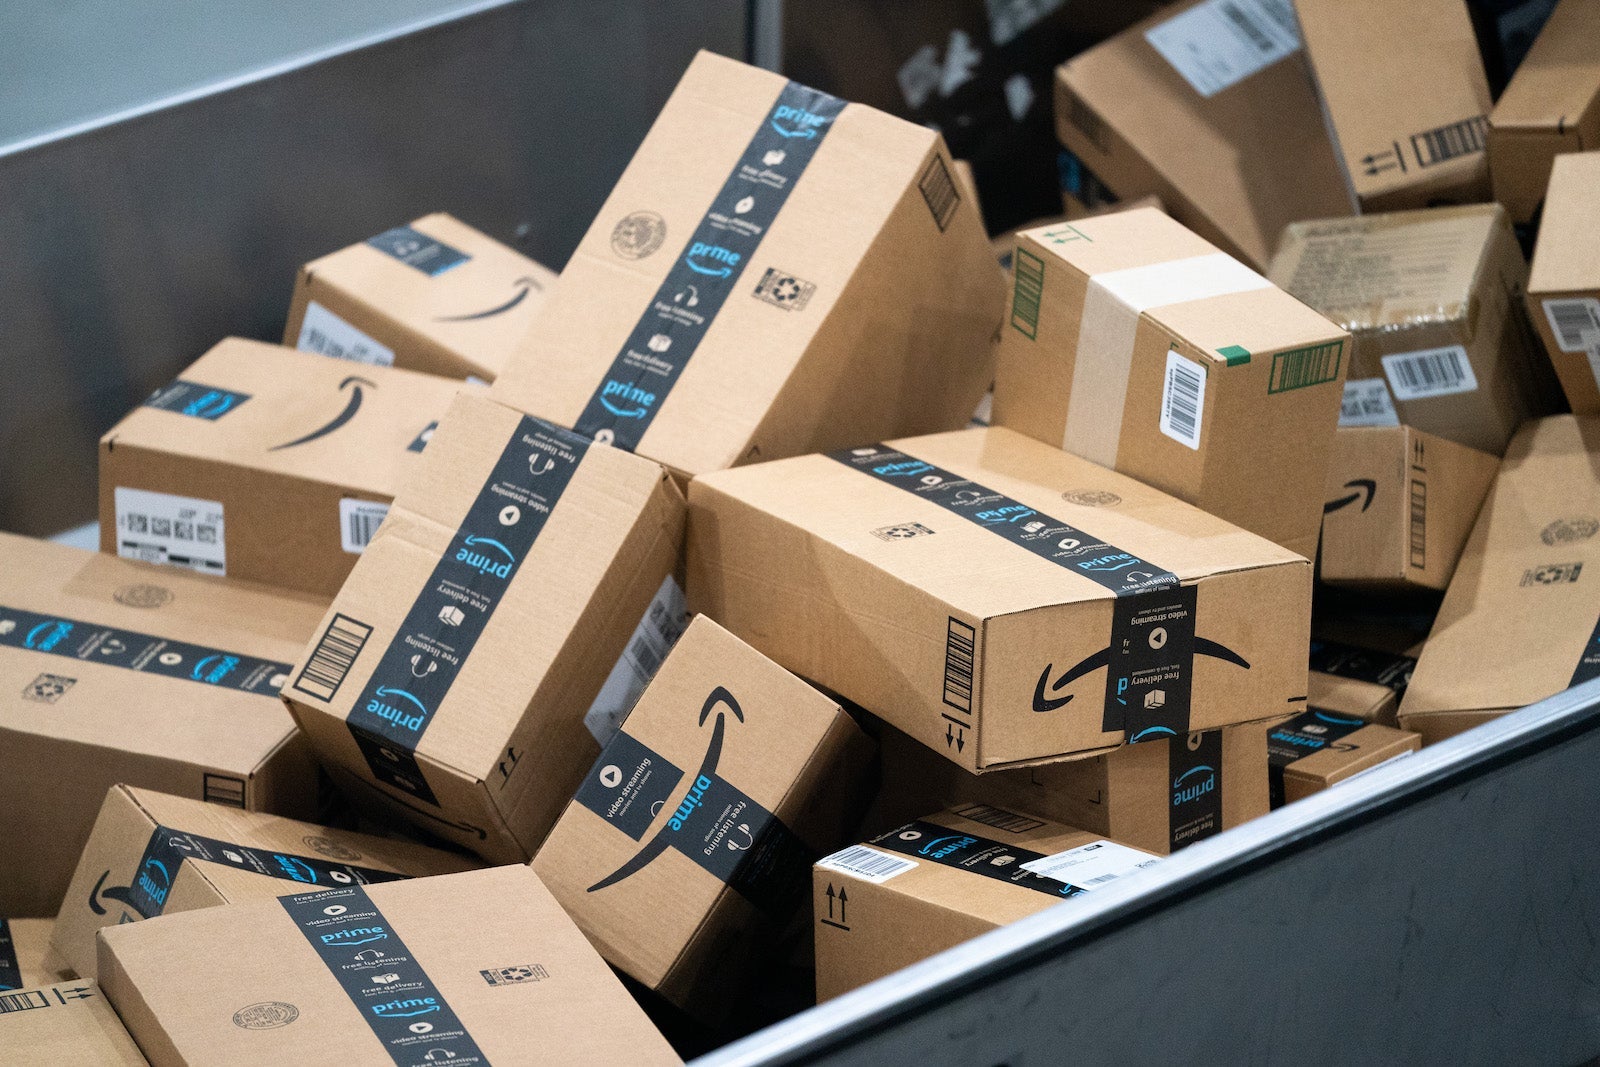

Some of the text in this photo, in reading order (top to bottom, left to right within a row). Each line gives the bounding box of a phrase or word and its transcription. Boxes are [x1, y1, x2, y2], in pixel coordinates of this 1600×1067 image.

[689, 242, 742, 266] prme
[602, 378, 656, 407] prime
[522, 434, 576, 464] free listening
[491, 483, 549, 513] video streaming
[975, 504, 1029, 521] prime
[456, 547, 513, 579] prime
[1077, 553, 1132, 570] prime
[1121, 575, 1177, 591] free listening
[437, 584, 488, 613] free delivery
[1131, 610, 1188, 626] video streaming
[404, 635, 459, 666] free listening
[1131, 672, 1179, 685] free delivery
[366, 699, 425, 731] prime
[607, 758, 651, 818] video streaming
[630, 789, 639, 800] and
[640, 770, 653, 785] shows
[1173, 773, 1215, 806] prime
[667, 774, 712, 831] prime
[703, 800, 747, 856] free listening
[1174, 826, 1200, 841] delivery
[1200, 820, 1214, 830] free
[704, 828, 716, 842] songs
[930, 836, 978, 859] prime
[139, 871, 168, 905] prime
[294, 888, 354, 903] free delivery
[305, 911, 377, 927] video streaming
[320, 926, 384, 944] prime
[341, 955, 407, 970] free listening
[361, 981, 423, 994] free delivery
[372, 997, 436, 1015] prime
[390, 1030, 464, 1044] video streaming
[434, 1057, 479, 1067] listening
